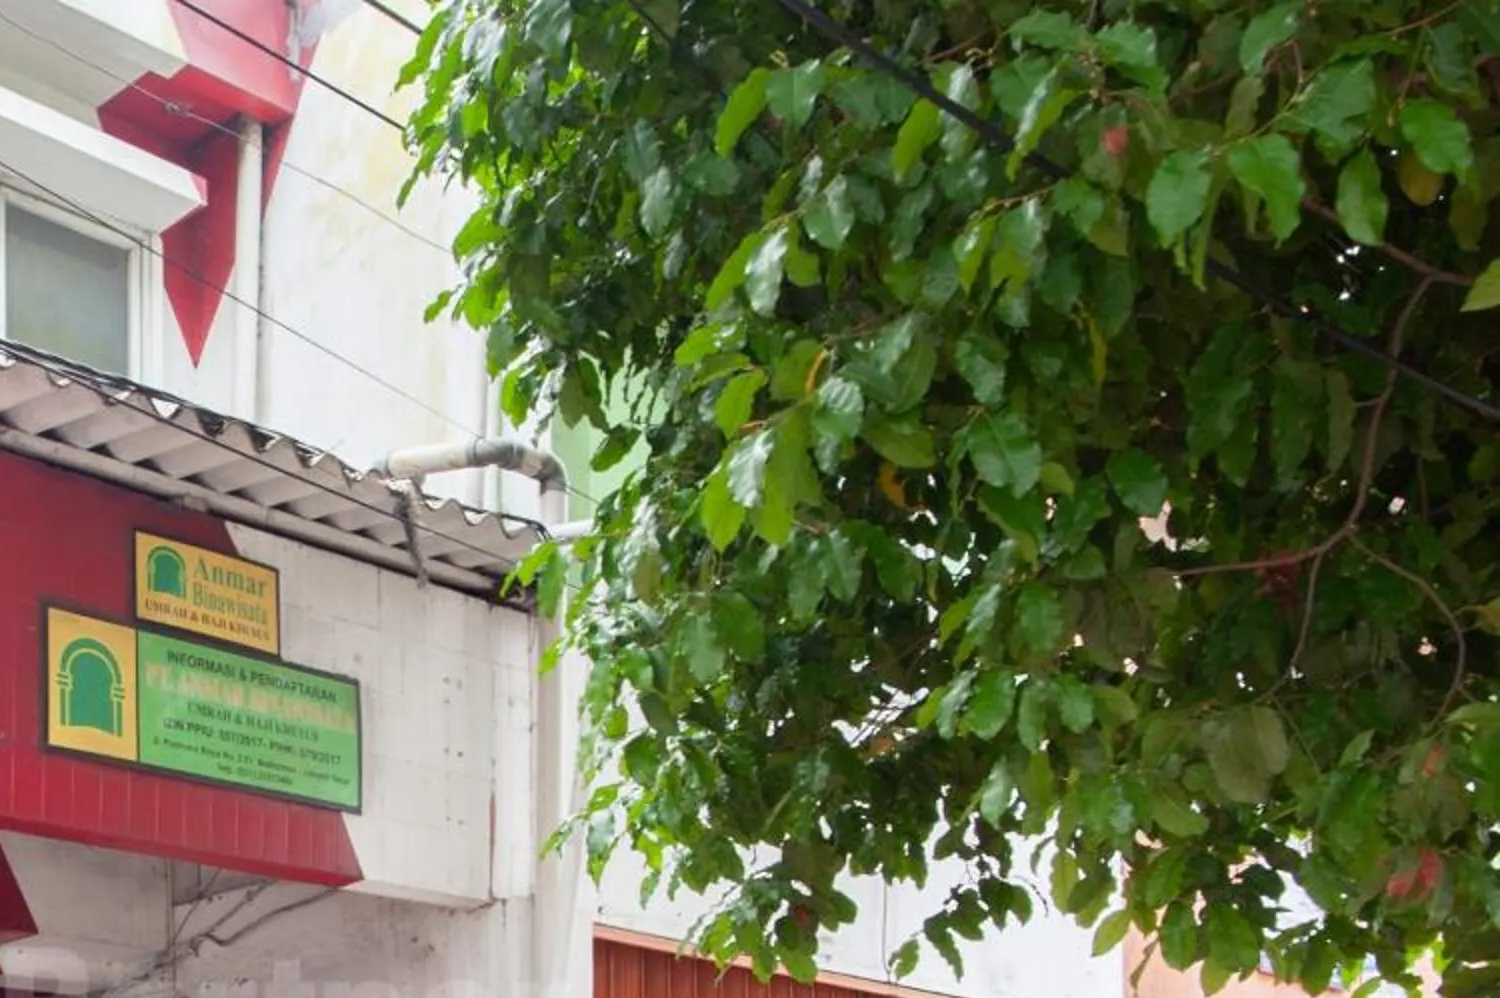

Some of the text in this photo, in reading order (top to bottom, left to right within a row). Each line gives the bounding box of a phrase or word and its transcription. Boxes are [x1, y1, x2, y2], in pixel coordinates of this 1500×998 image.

[193, 556, 268, 598] Anmar
[167, 649, 235, 679] INFORMASI
[250, 670, 337, 703] PENDAFTARAN
